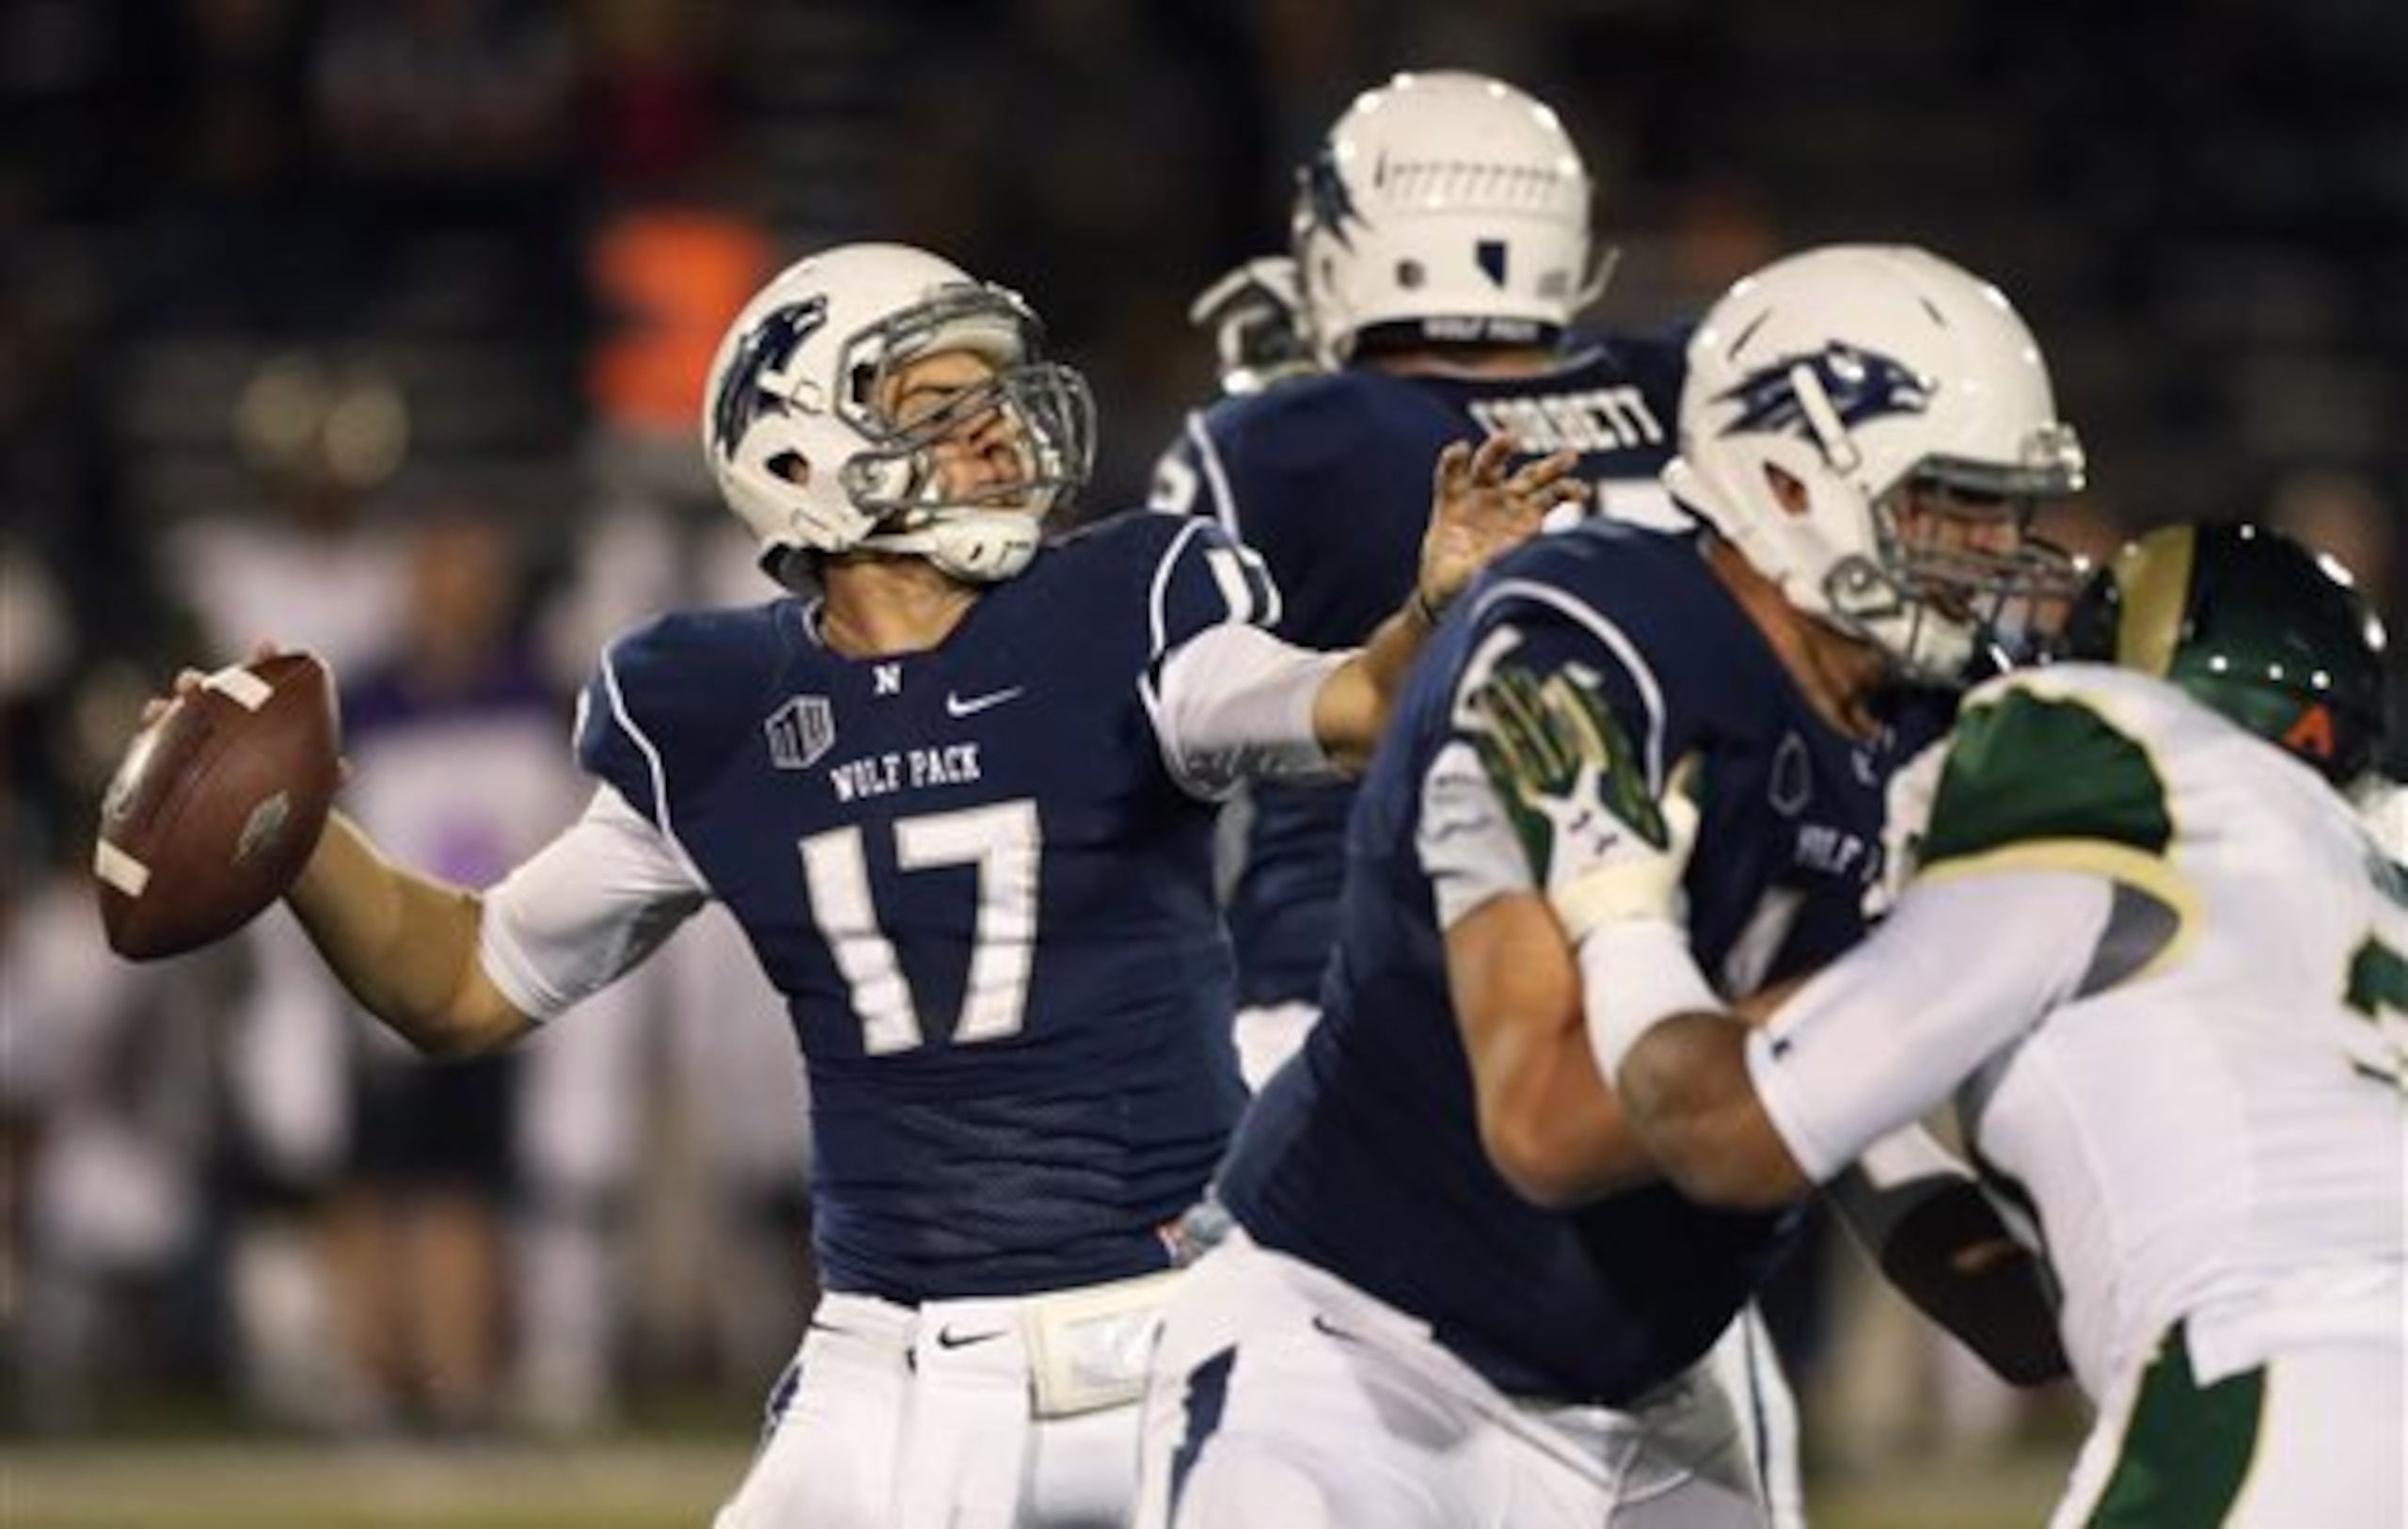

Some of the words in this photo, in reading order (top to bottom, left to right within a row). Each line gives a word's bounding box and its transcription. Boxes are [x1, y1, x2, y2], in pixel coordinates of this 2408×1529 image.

[873, 663, 901, 694] N
[831, 755, 900, 801] WOLF
[908, 742, 981, 788] PACK
[799, 799, 1041, 1055] 17
